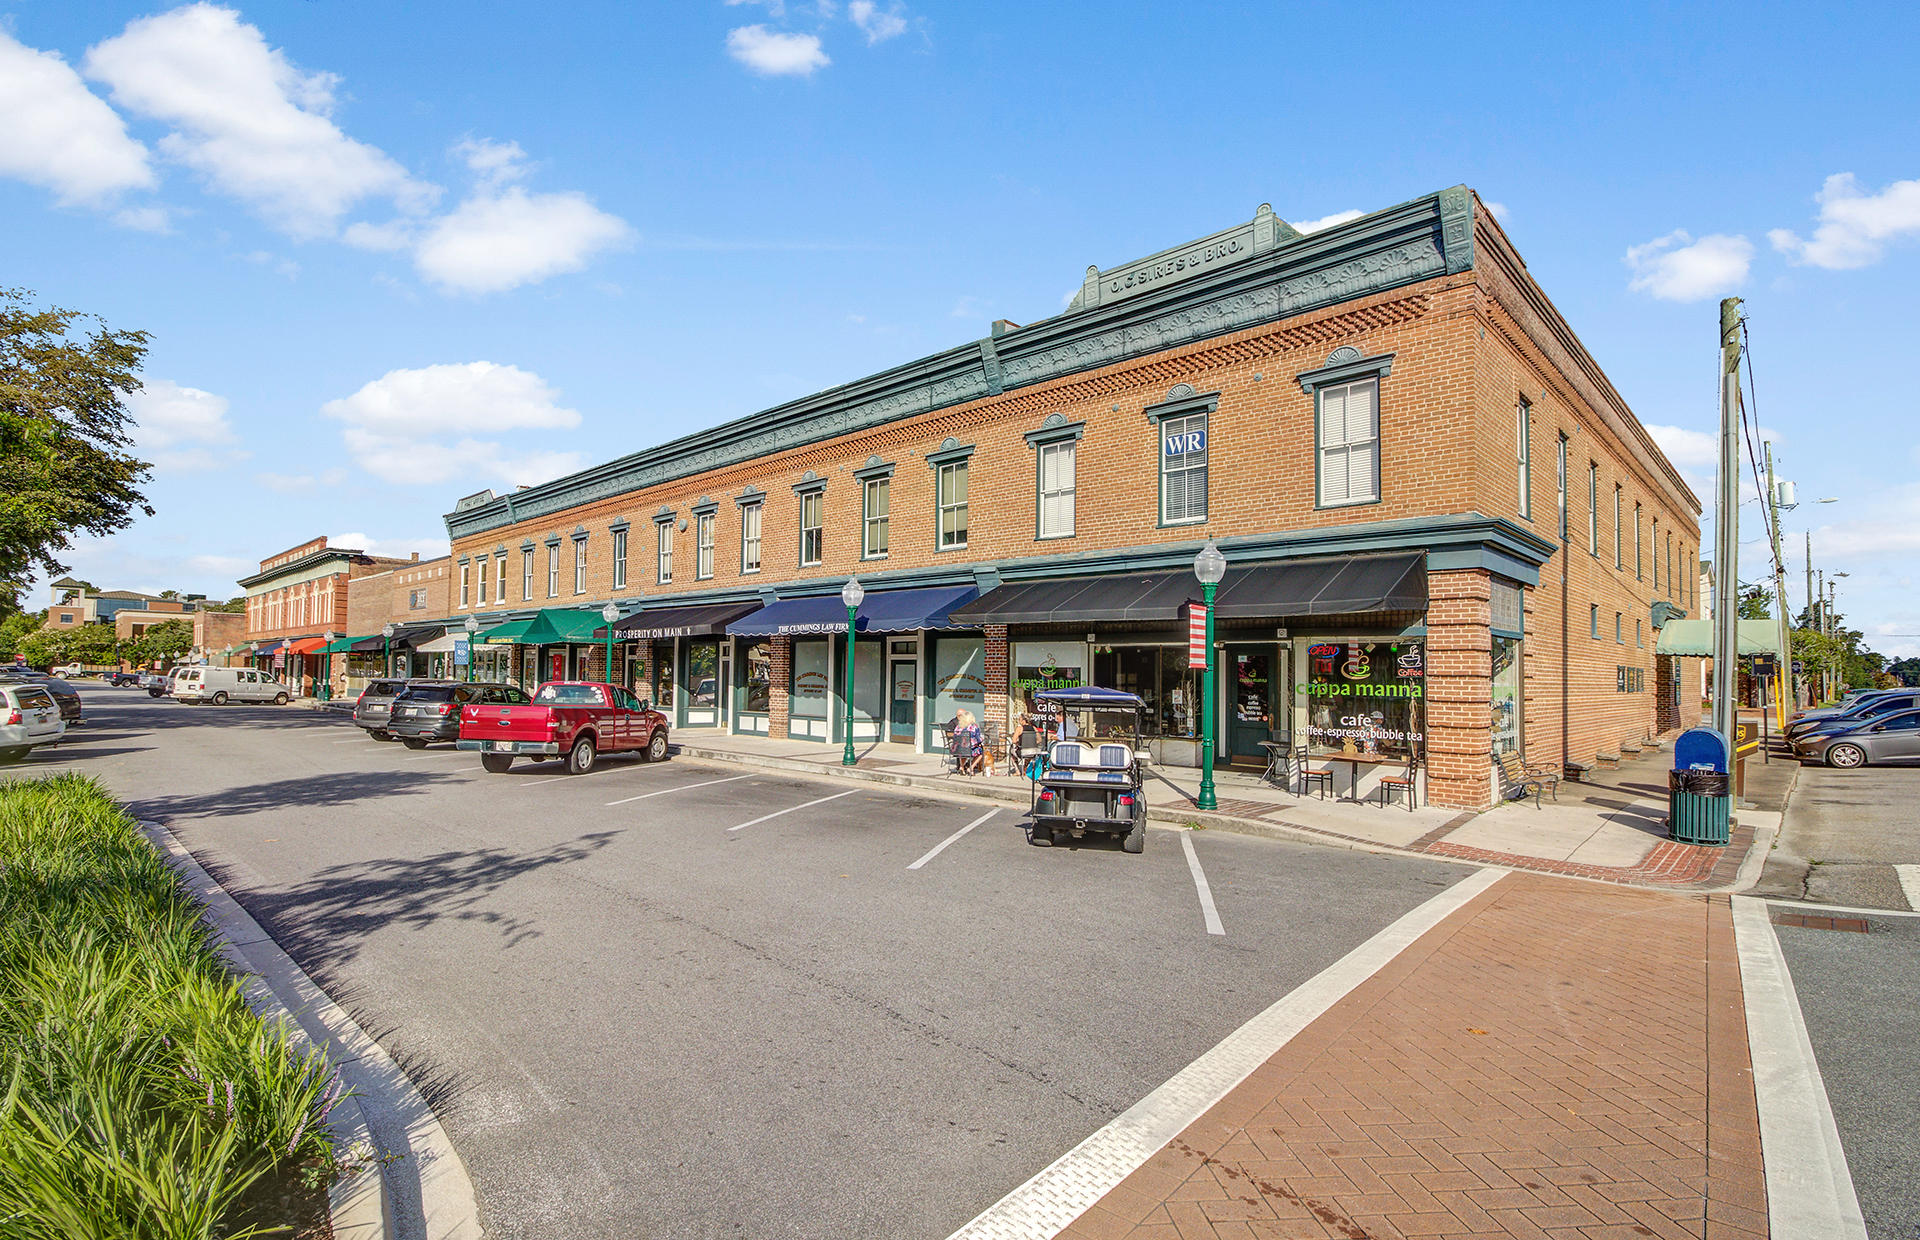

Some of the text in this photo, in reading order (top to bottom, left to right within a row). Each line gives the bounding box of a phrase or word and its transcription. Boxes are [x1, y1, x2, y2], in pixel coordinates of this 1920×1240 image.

[1110, 281, 1123, 293] O.
[1138, 259, 1185, 284] SIRES
[1189, 255, 1201, 267] &
[1204, 240, 1244, 262] BRO.
[1167, 433, 1202, 454] WR
[615, 627, 682, 639] PROSPERITY ON MAIN
[778, 625, 790, 633] THE
[790, 623, 820, 632] CUMMINGS
[821, 623, 835, 631] LAW
[1309, 645, 1337, 657] OPEN
[1397, 668, 1423, 677] Coffee
[1011, 678, 1087, 691] cuppa manna
[1296, 683, 1422, 698] cuppa manna
[1037, 702, 1056, 712] cafe
[1340, 714, 1371, 727] cafe
[1407, 731, 1423, 742] tea
